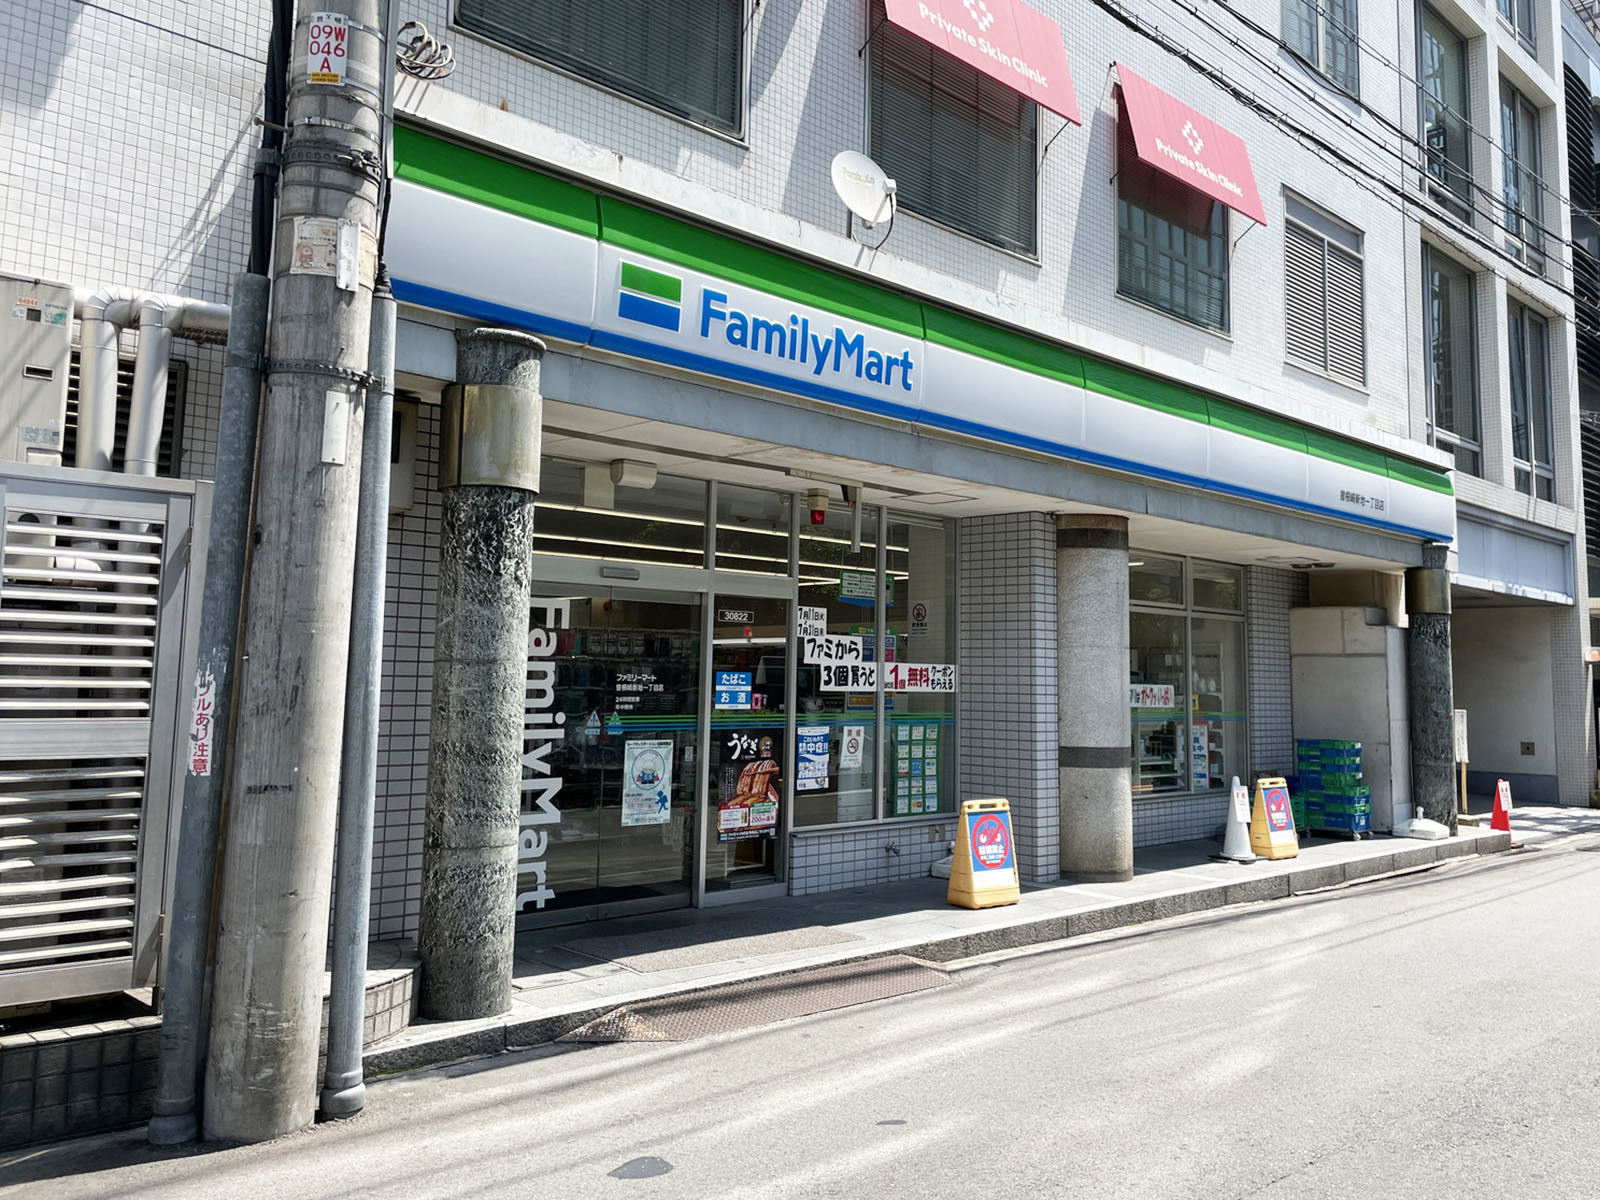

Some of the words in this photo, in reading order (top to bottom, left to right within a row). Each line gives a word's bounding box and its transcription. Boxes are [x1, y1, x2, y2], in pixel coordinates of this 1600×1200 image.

[310, 24, 346, 42] 09W
[309, 40, 346, 57] 046
[918, 2, 976, 47] Private
[978, 37, 1011, 67] Skin
[1012, 56, 1048, 88] Clinic
[319, 56, 332, 73] A
[1155, 137, 1195, 170] Private
[1194, 160, 1219, 184] Skin
[1217, 173, 1244, 198] Clinic
[700, 288, 913, 391] FamilyMart
[724, 611, 748, 621] 30822
[806, 637, 861, 661] ファミから
[616, 673, 658, 683] ファミリーマート
[721, 673, 747, 685] たばこ
[515, 598, 571, 913] FamilyMart
[727, 732, 759, 760] うなぎ
